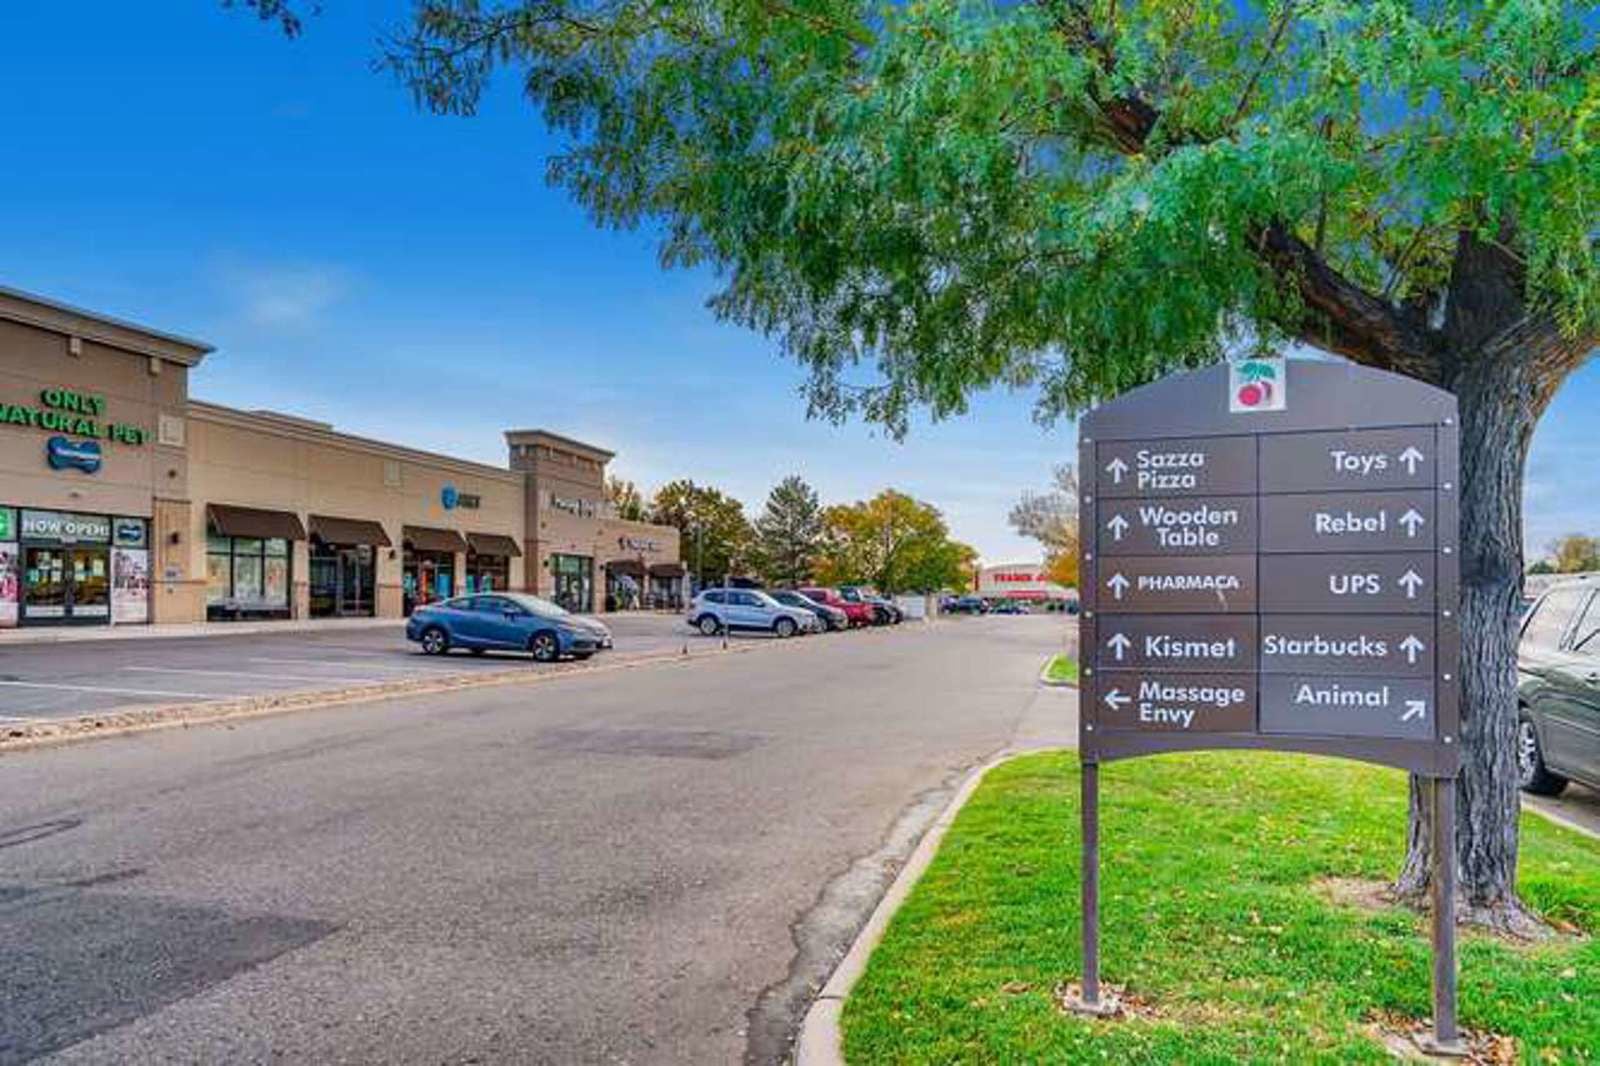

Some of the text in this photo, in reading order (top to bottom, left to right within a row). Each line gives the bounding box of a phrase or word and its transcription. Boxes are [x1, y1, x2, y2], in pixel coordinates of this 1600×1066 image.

[42, 387, 106, 415] ONLY
[1136, 451, 1204, 469] Sazza
[1330, 451, 1388, 475] Toys
[1137, 470, 1196, 489] Pizza
[1139, 505, 1238, 525] Wooden
[1315, 510, 1386, 533] Rebel
[22, 519, 60, 532] NOW
[65, 522, 110, 536] OPEN
[1157, 527, 1220, 546] Table
[1138, 575, 1239, 590] PHARMACA
[1329, 574, 1380, 594] UPS
[1145, 635, 1235, 657] Kismet
[1264, 635, 1388, 656] Starbucks
[1139, 681, 1245, 707] Massage
[1296, 684, 1389, 706] Animal
[1140, 703, 1196, 728] Envy
